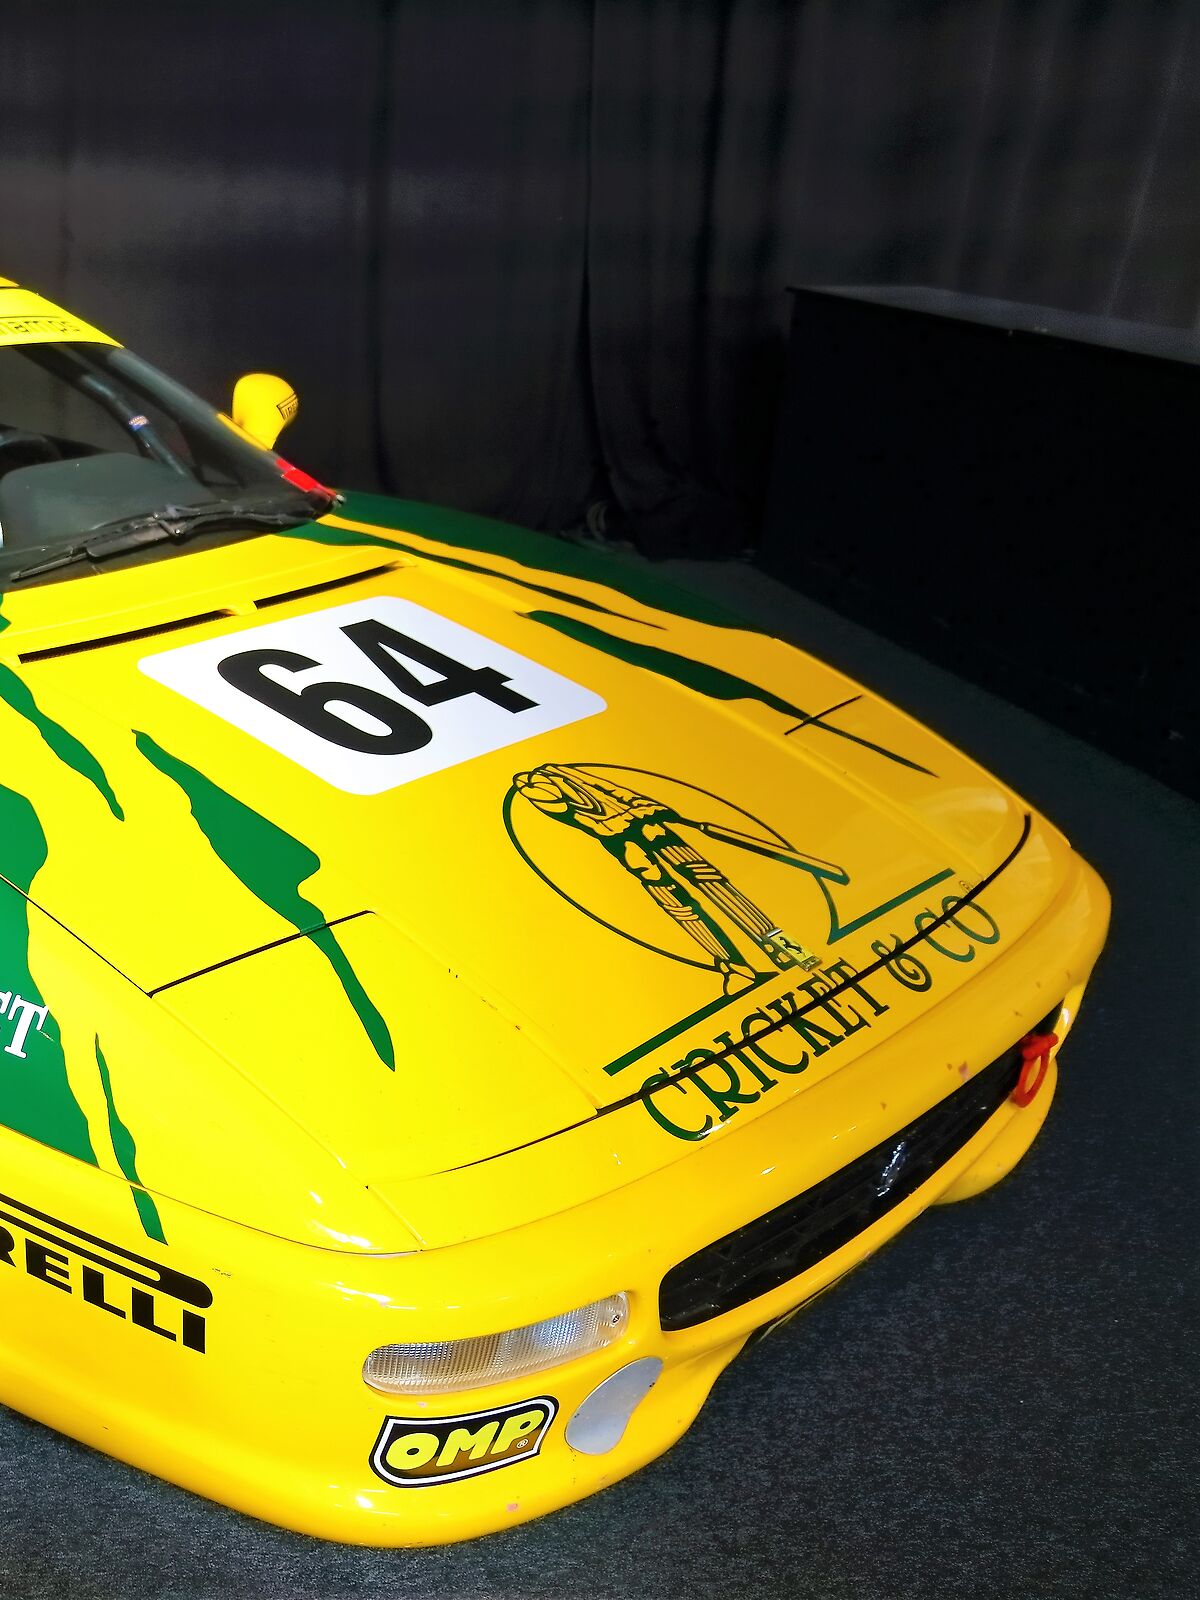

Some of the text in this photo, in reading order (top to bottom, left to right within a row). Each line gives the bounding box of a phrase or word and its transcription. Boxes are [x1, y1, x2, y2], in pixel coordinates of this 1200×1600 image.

[216, 618, 541, 756] 64
[641, 894, 1001, 1142] CRICKET & CO
[385, 1408, 545, 1470] OMP
